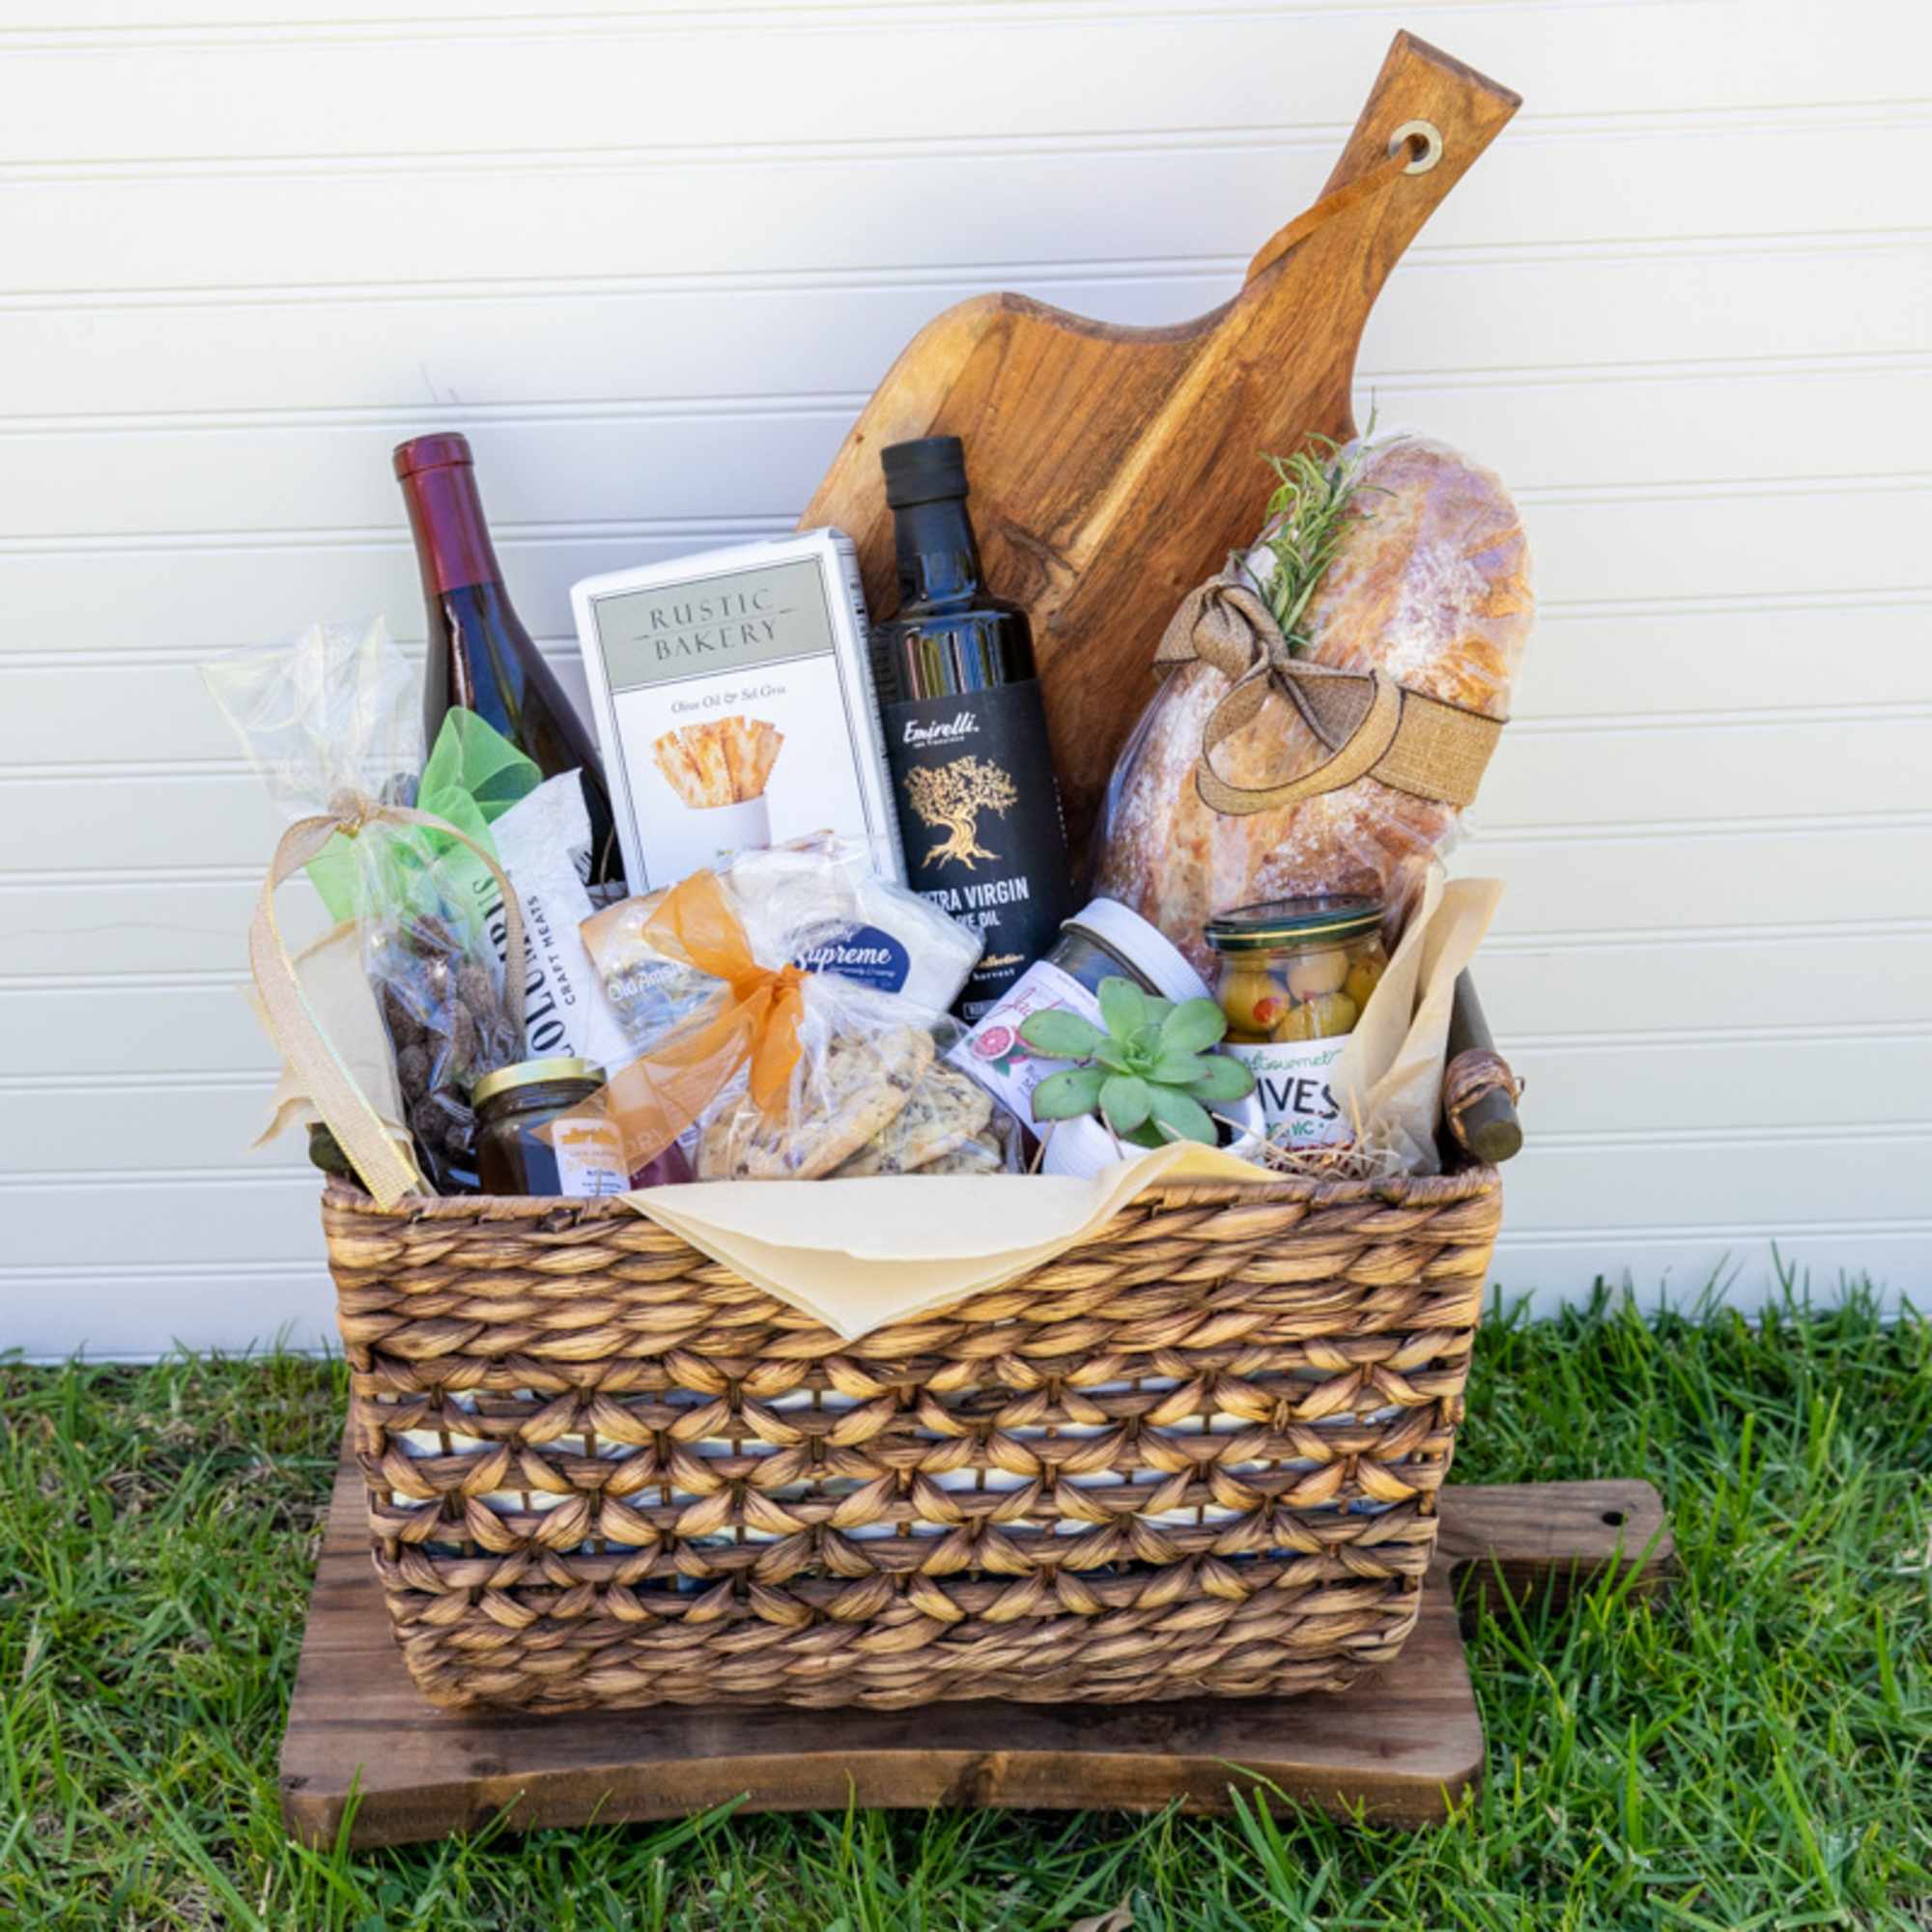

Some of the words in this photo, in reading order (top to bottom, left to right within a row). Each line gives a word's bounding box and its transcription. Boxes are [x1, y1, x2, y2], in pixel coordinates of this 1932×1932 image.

[649, 588, 773, 629] RUSTIC
[655, 619, 776, 661] BAKERY
[670, 699, 699, 714] Olive
[963, 876, 1030, 910] VIRGIN
[526, 895, 555, 949] MEATS
[978, 910, 1001, 928] OIL
[548, 952, 576, 1006] CRAFT
[1256, 1076, 1341, 1121] IVES
